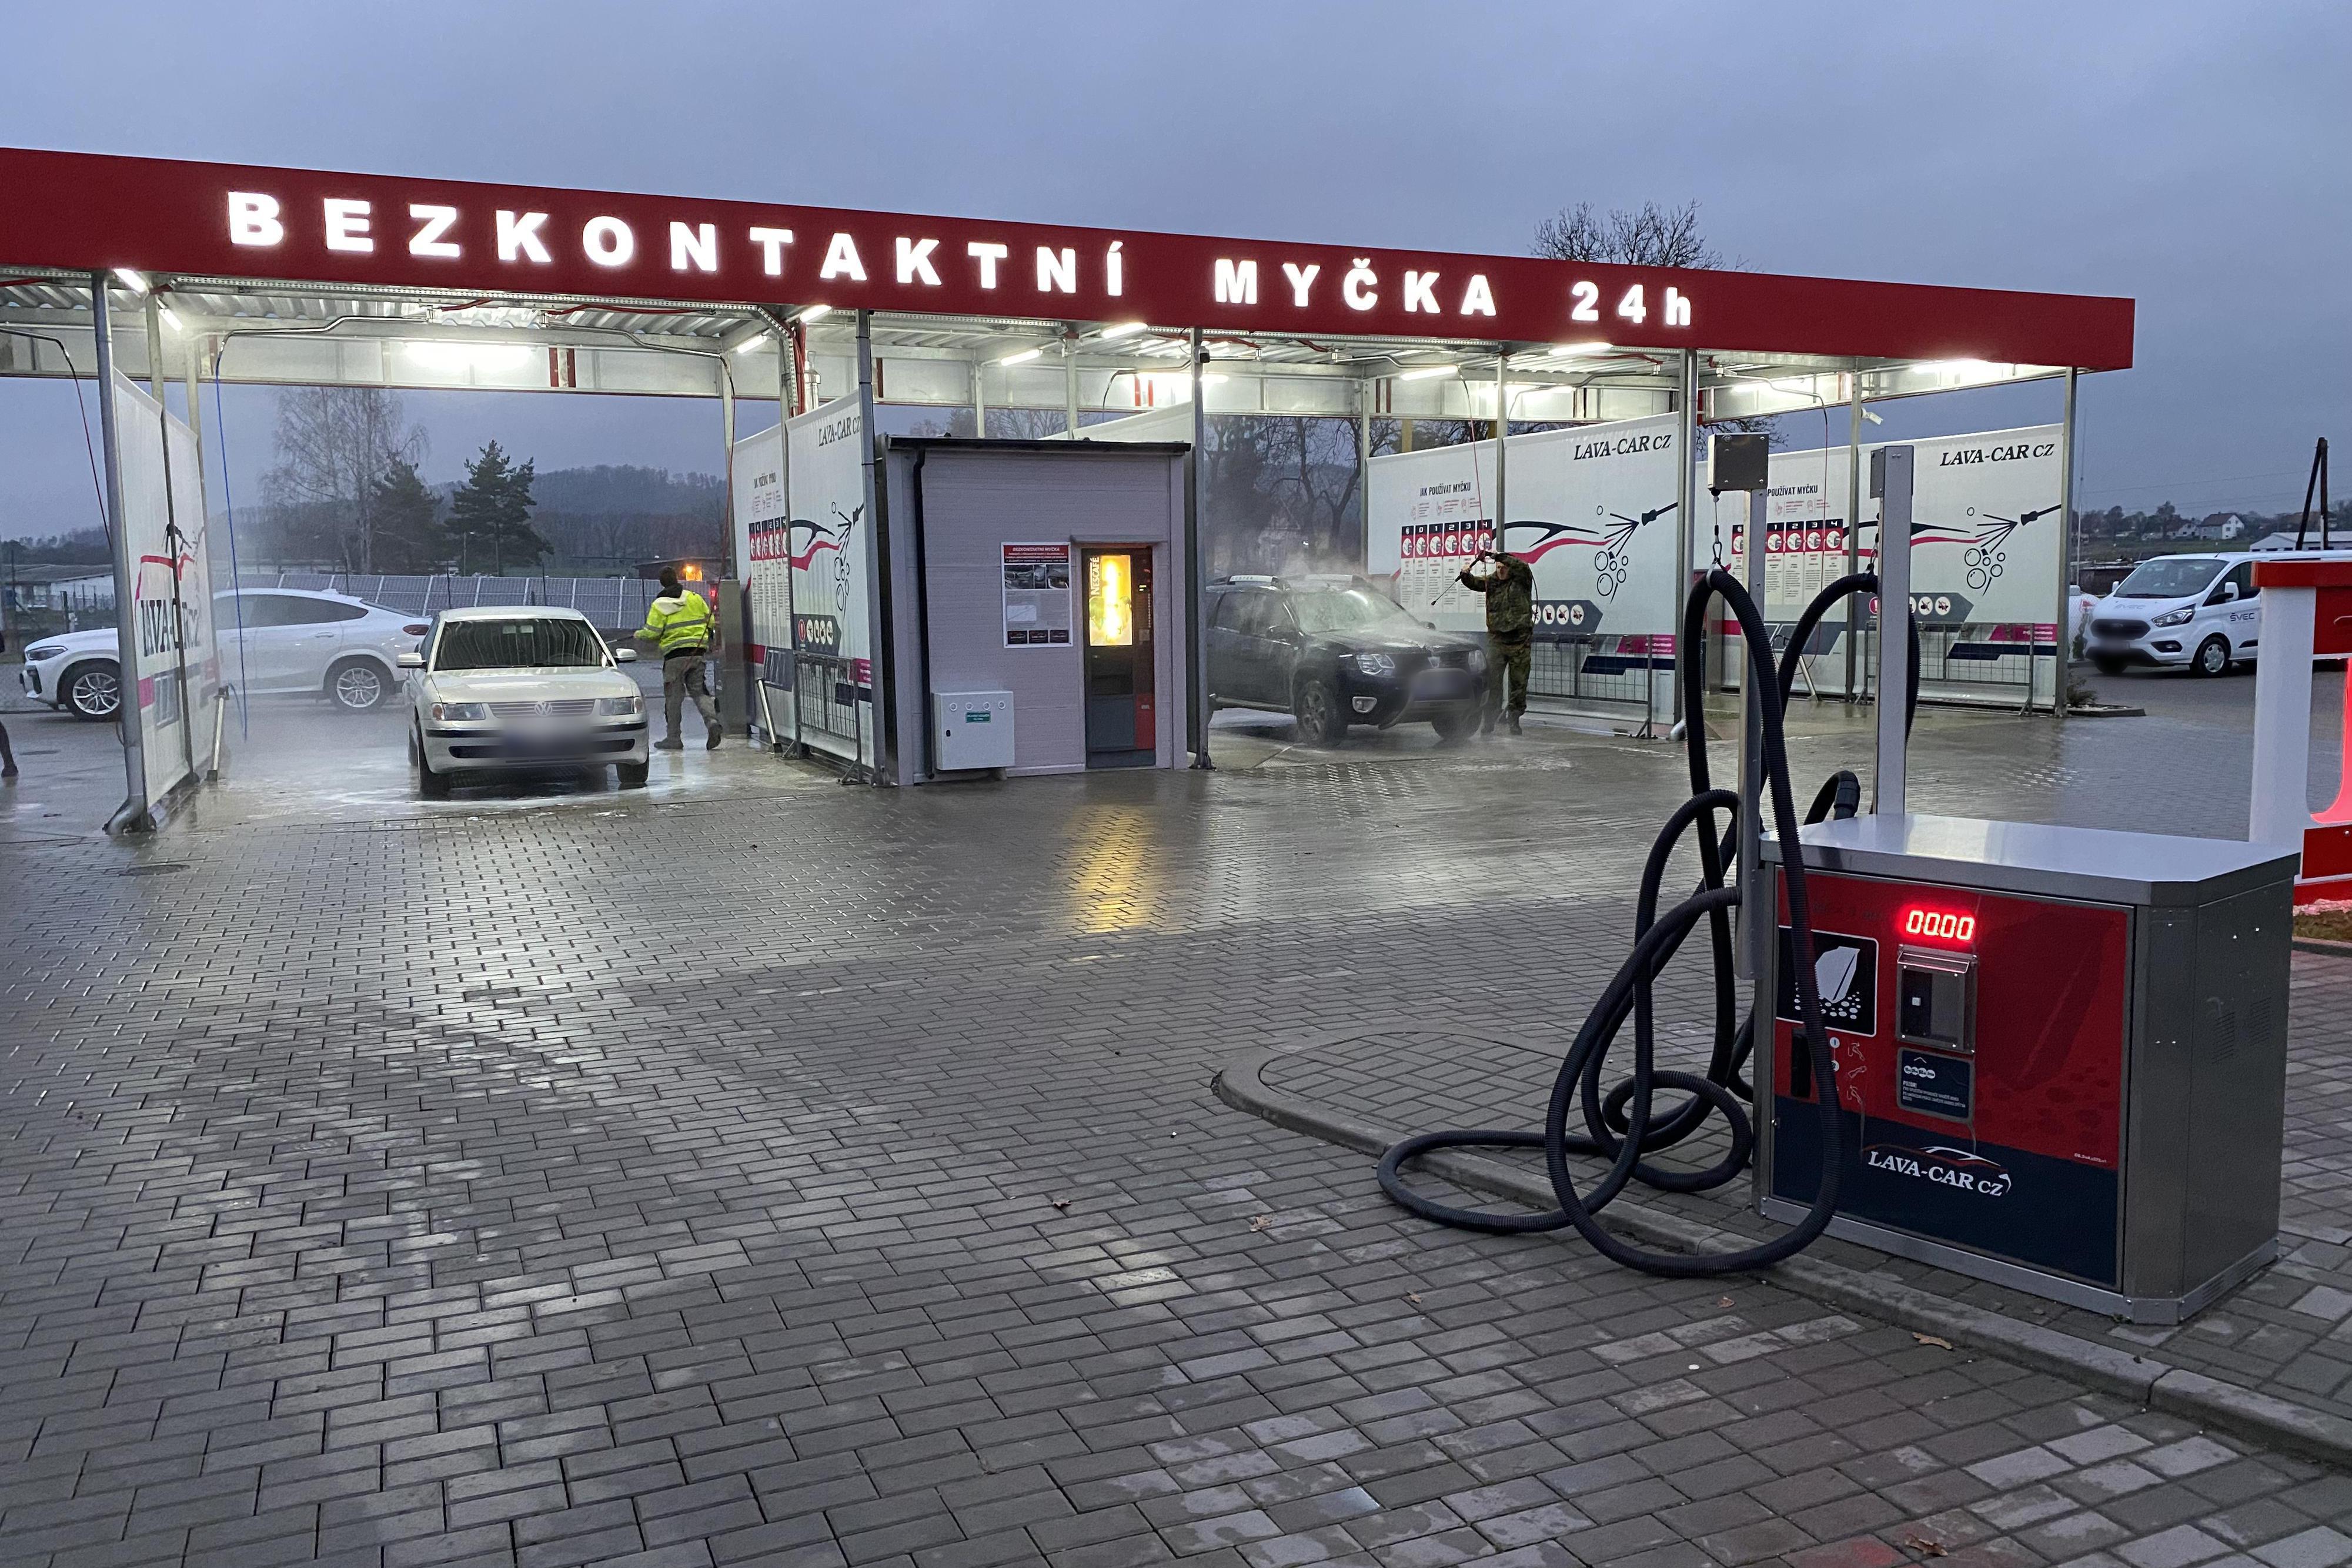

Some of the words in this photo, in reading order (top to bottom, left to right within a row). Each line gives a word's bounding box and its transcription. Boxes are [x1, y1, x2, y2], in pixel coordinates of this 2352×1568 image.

[227, 191, 1124, 297] BEZKONTAKTNÍ
[1214, 258, 1497, 317] MYČKA
[1571, 280, 1692, 326] 24h
[818, 416, 852, 447] LAVA-CAR
[1573, 436, 1651, 460] LAVA-CAR
[1652, 434, 1672, 450] CZ
[1939, 444, 2030, 466] LAVA-CAR
[2033, 443, 2055, 457] CZ
[1419, 487, 1428, 497] JAK
[1429, 483, 1452, 496] POUŽÍVAT
[1452, 480, 1471, 493] MYČKU
[1767, 485, 1796, 497] POUŽÍVAT
[1797, 483, 1818, 494] MYČKU
[1090, 556, 1101, 596] NESCAFÉ
[2230, 612, 2256, 621] ŠVEC
[1867, 1151, 1974, 1190] LAVA-CAR
[1977, 1180, 2004, 1196] CZ
